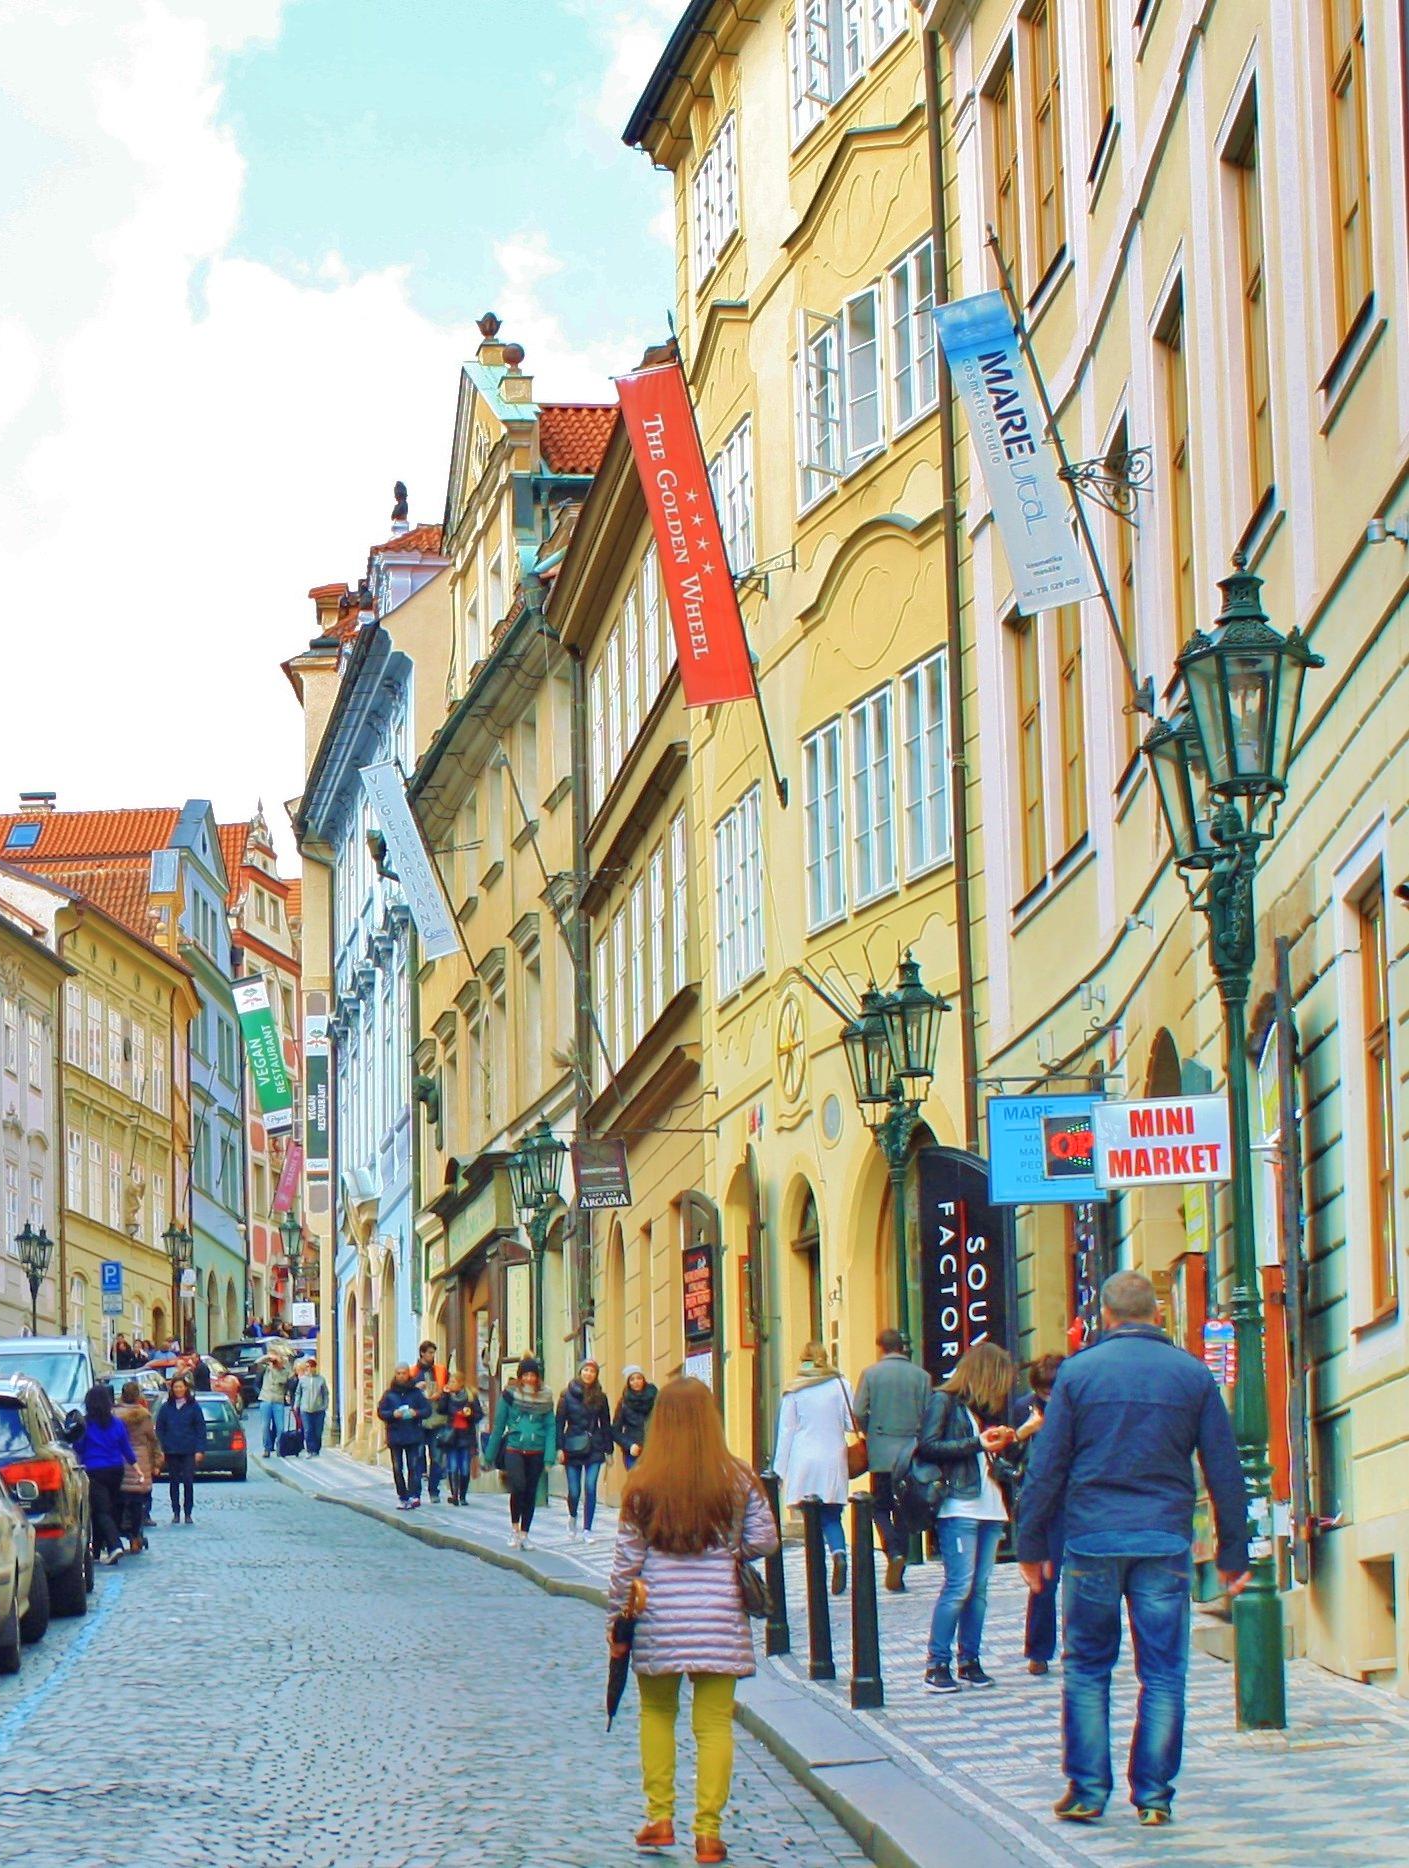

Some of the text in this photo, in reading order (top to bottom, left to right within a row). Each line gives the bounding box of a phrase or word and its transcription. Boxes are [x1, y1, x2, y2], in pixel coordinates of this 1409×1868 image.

[981, 421, 1001, 464] studio
[642, 413, 710, 661] THE GOLDEN WHEEL
[368, 773, 433, 926] VEGETARIAN
[248, 1038, 271, 1087] VEGAN
[260, 1024, 287, 1094] RESTAURANT
[1129, 1106, 1195, 1139] MINI
[1107, 1143, 1222, 1180] MARKET
[579, 1192, 629, 1208] ARCADIA
